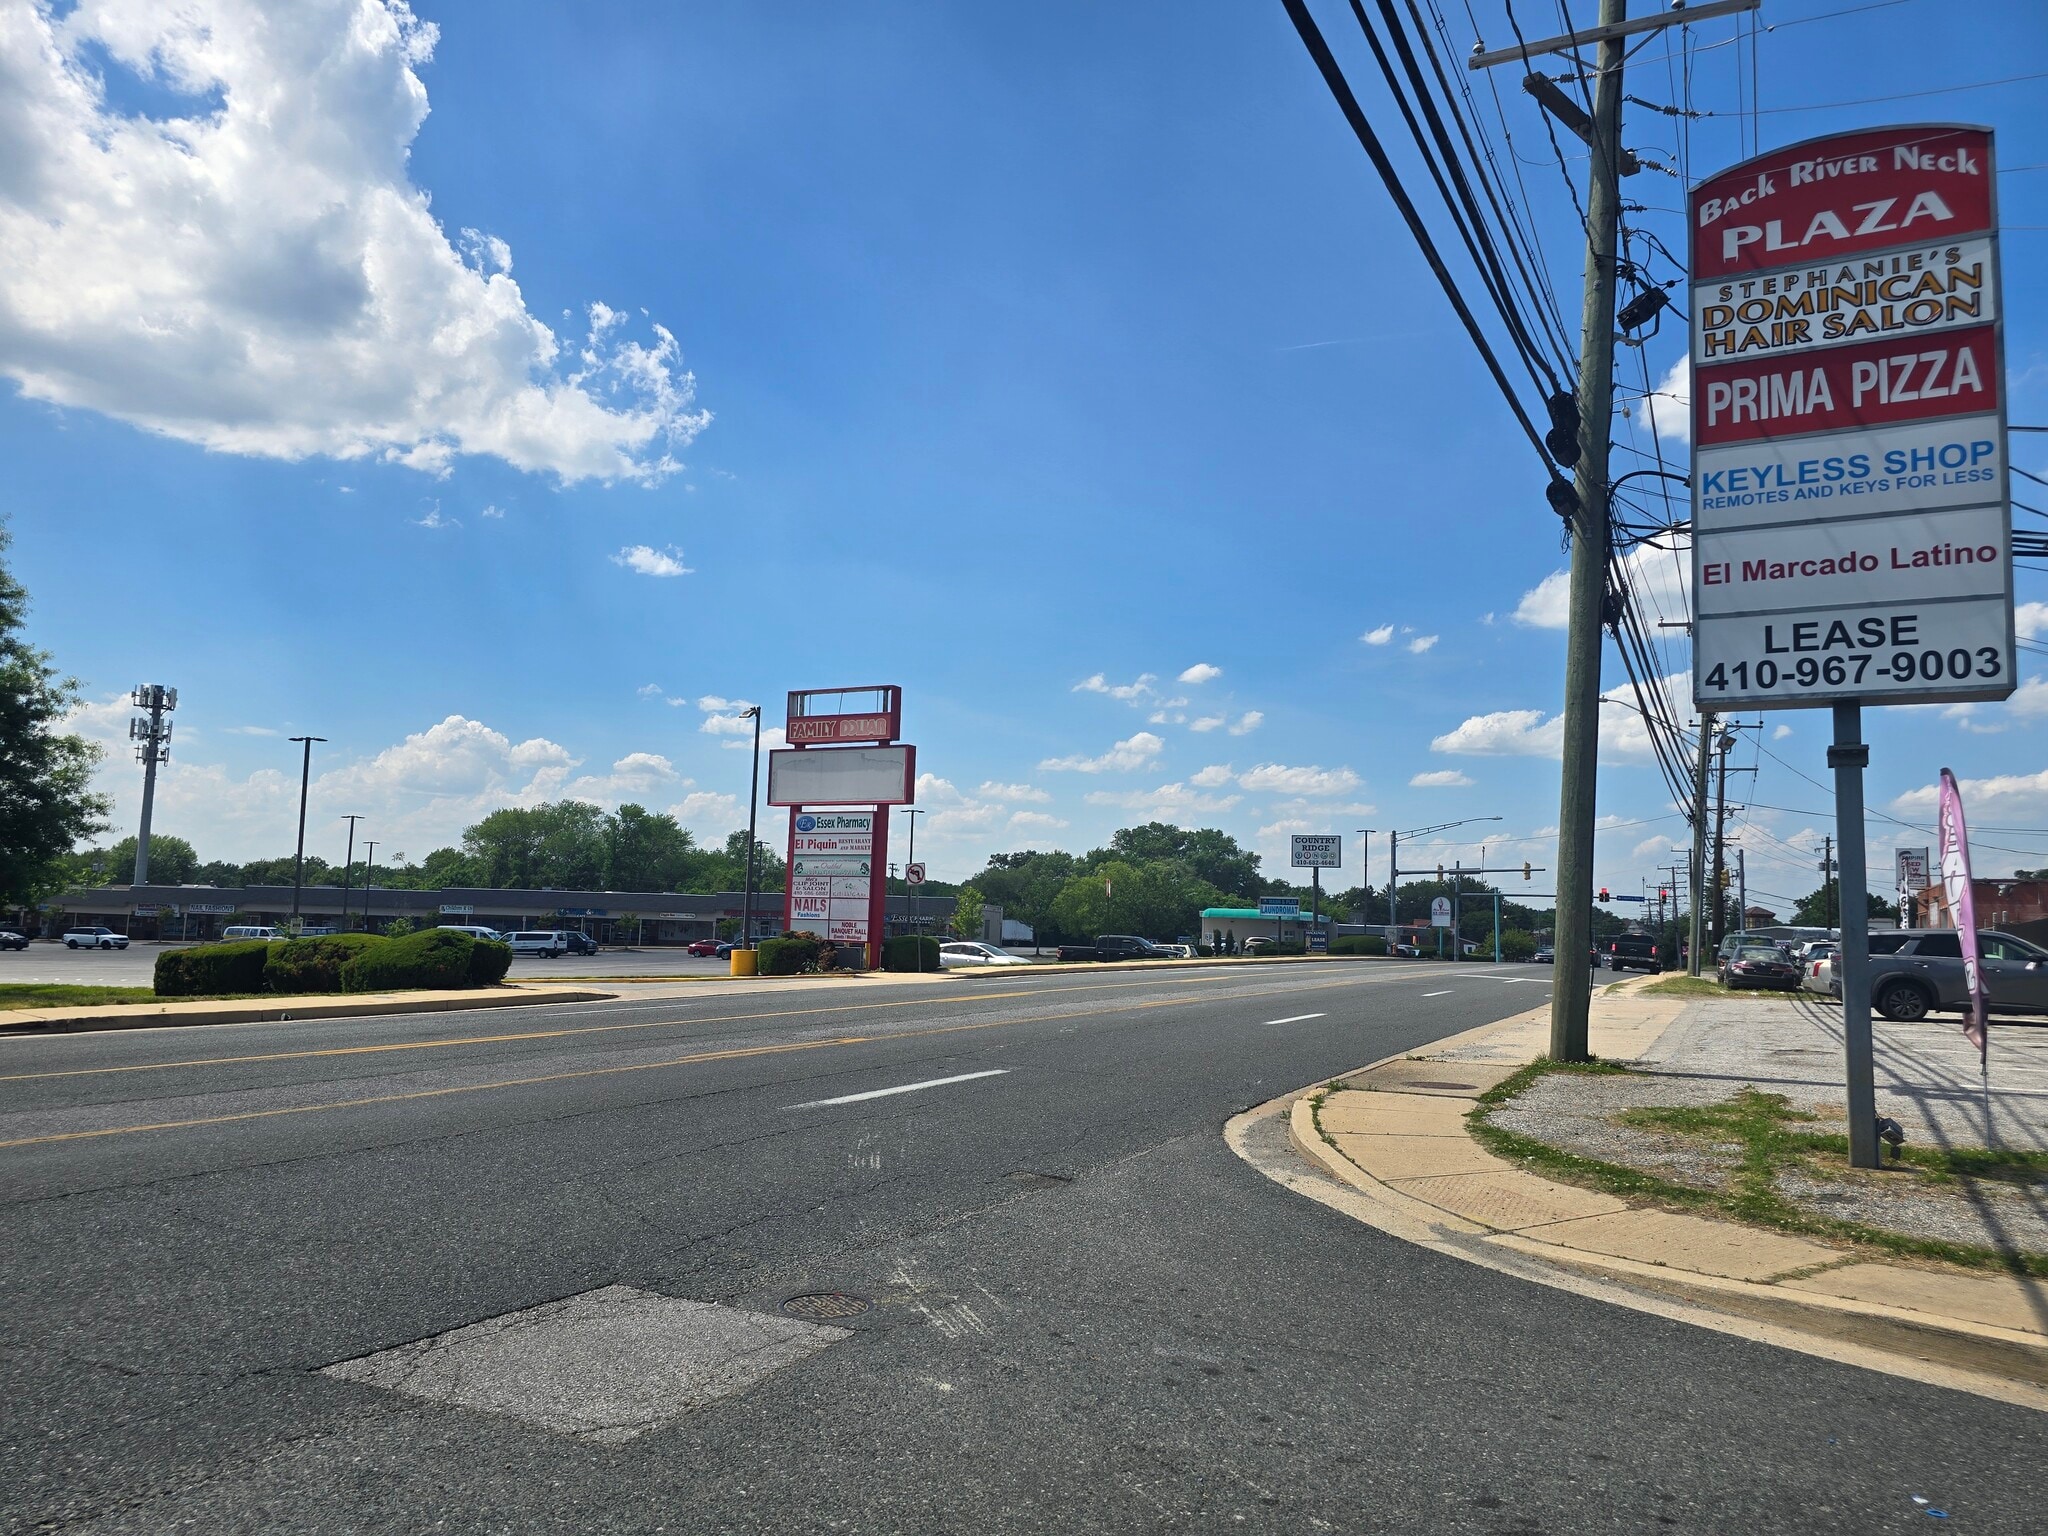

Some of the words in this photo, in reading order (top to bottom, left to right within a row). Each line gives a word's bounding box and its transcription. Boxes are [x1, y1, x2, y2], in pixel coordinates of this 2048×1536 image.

[1700, 173, 1776, 227] Back
[1790, 157, 1878, 188] River
[1894, 145, 1979, 175] Neck
[1723, 191, 1954, 263] PLAZA
[1719, 247, 1961, 302] STEPHANIE'S
[1703, 262, 1982, 331] DOMINICAN
[1704, 320, 1812, 357] HAIR
[1823, 292, 1981, 338] SALON
[1707, 368, 1834, 427] PRIMA
[1852, 347, 1983, 408] PIZZA
[1703, 454, 1871, 495] KEYLESS
[1884, 440, 1994, 475] SHOP
[1703, 489, 1789, 510] REMOTES
[1794, 485, 1834, 501] AND
[1839, 479, 1890, 496] KEYS
[1896, 474, 1936, 490] FOR
[1942, 468, 1994, 485] LESS
[1703, 562, 1731, 585] El
[1742, 551, 1879, 582] Marcado
[1890, 543, 1997, 570] Latino
[1764, 615, 1919, 654] LEASE
[1704, 646, 2001, 691] 410-967-9003
[789, 720, 837, 739] FAMILY
[807, 838, 837, 851] Piquin
[816, 817, 835, 829] Essex
[836, 816, 871, 831] Pharmacy
[794, 898, 827, 912] NAILS
[1261, 905, 1299, 914] LAUNDROMAT
